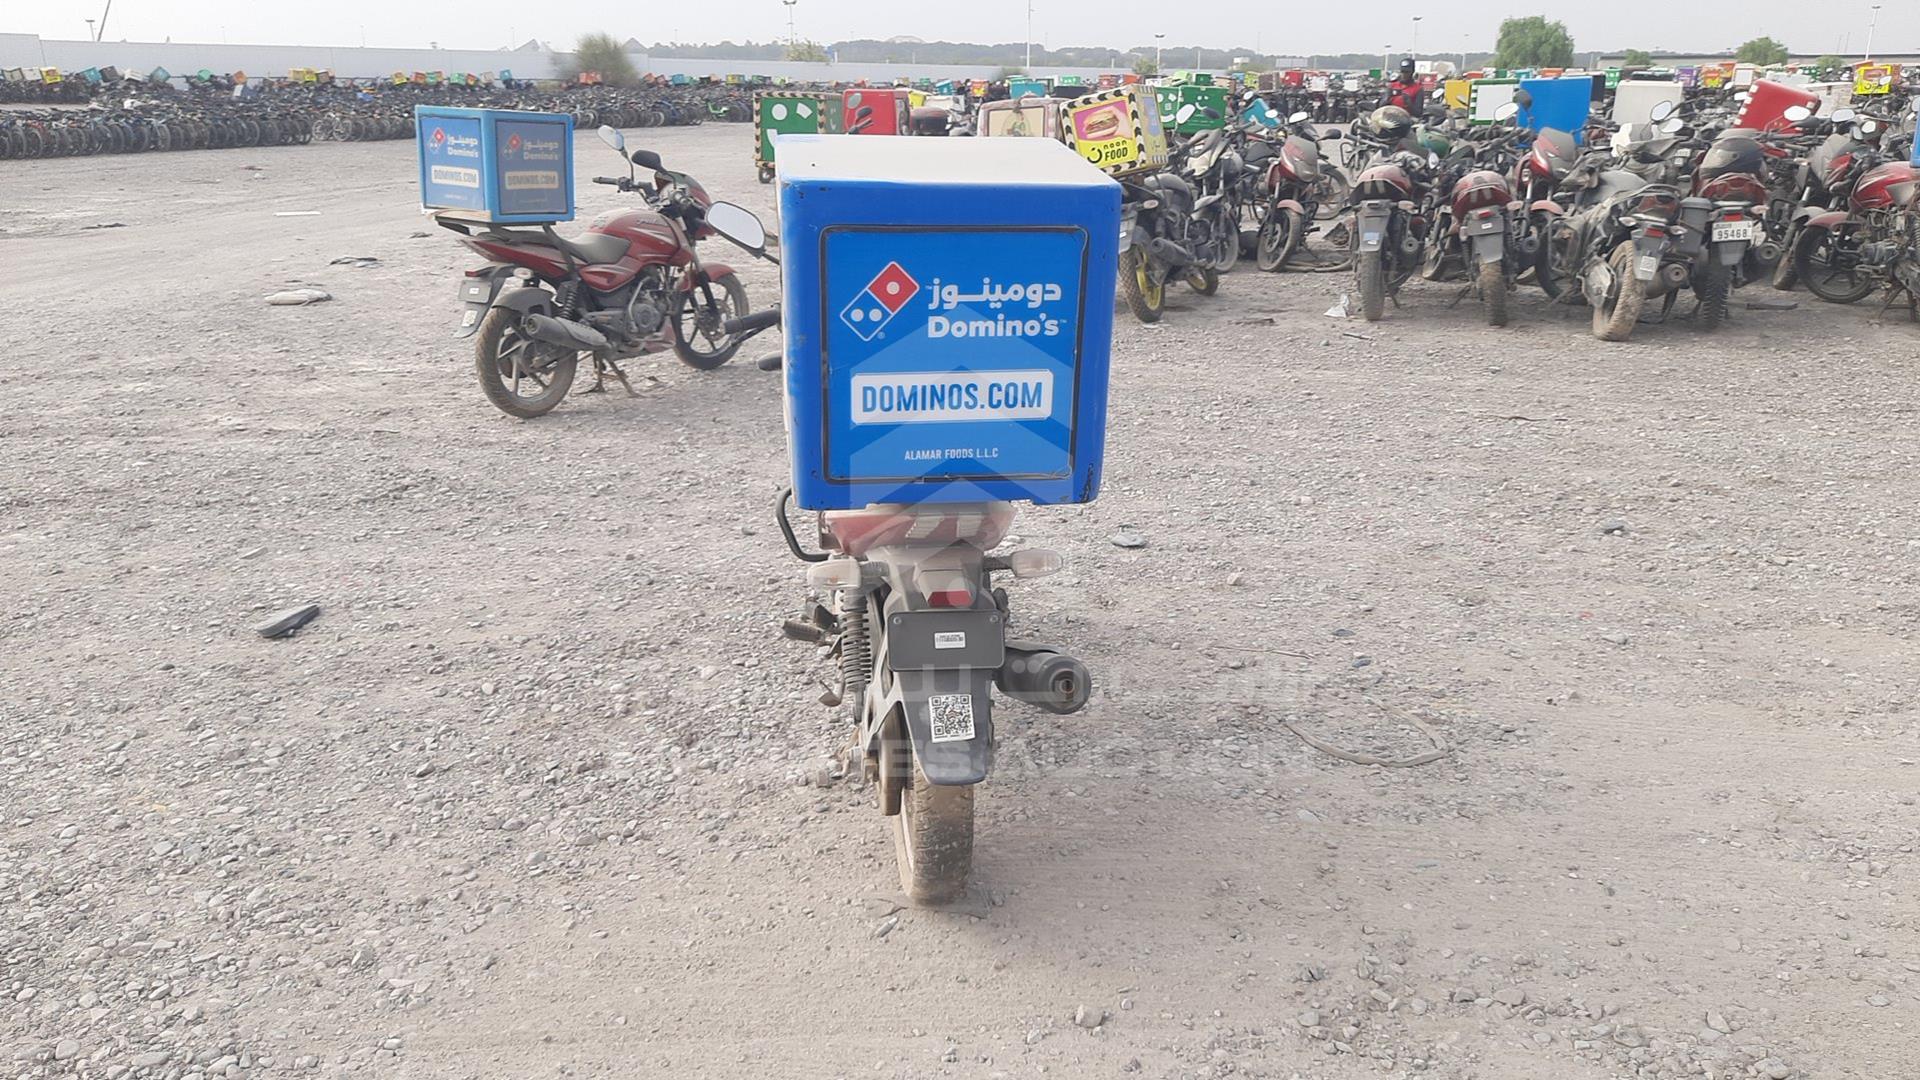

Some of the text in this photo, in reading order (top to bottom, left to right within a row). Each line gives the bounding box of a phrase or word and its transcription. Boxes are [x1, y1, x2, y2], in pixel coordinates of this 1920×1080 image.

[1104, 147, 1128, 161] FOOD
[927, 313, 1060, 338] Domino's
[861, 381, 1043, 413] DOMINOS.COM
[904, 449, 942, 461] ALAMAR
[944, 447, 974, 460] FOODS
